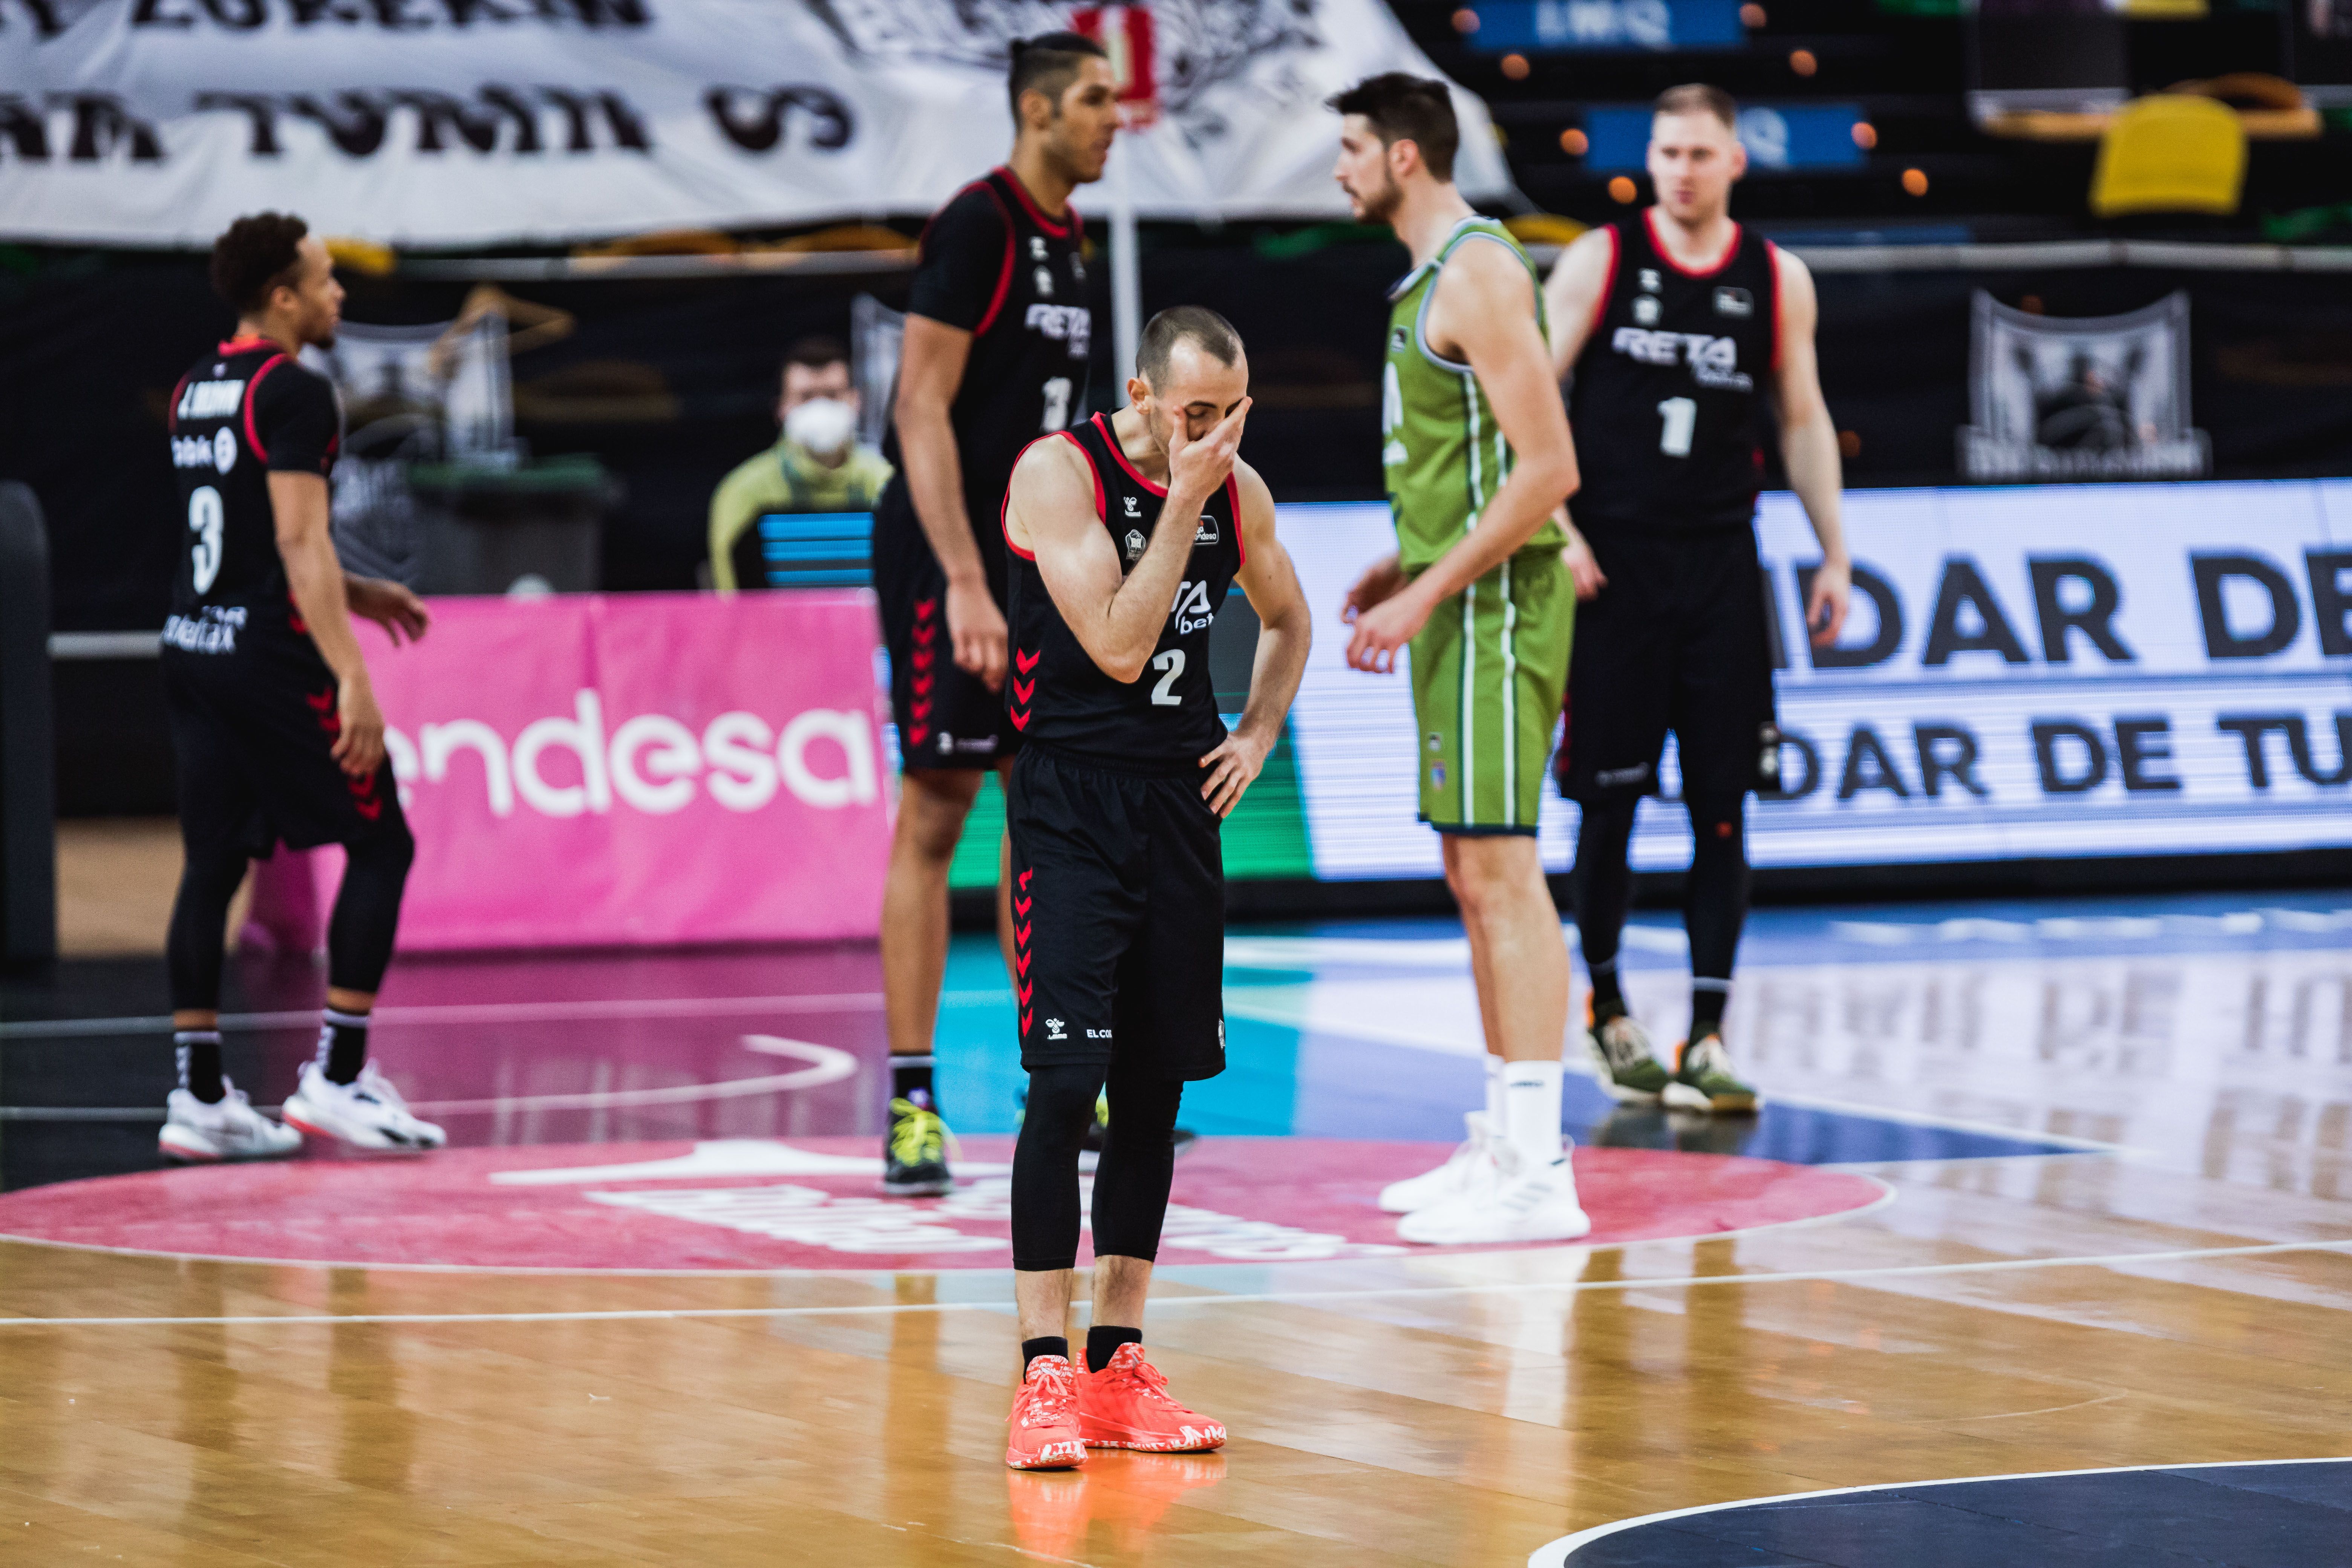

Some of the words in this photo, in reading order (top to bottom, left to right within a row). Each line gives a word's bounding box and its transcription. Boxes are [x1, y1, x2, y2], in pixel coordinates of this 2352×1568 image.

[1657, 396, 1697, 457] 1
[188, 485, 224, 595] 3
[1180, 612, 1214, 635] bet
[1151, 649, 1186, 706] 2
[2029, 719, 2182, 793] DE
